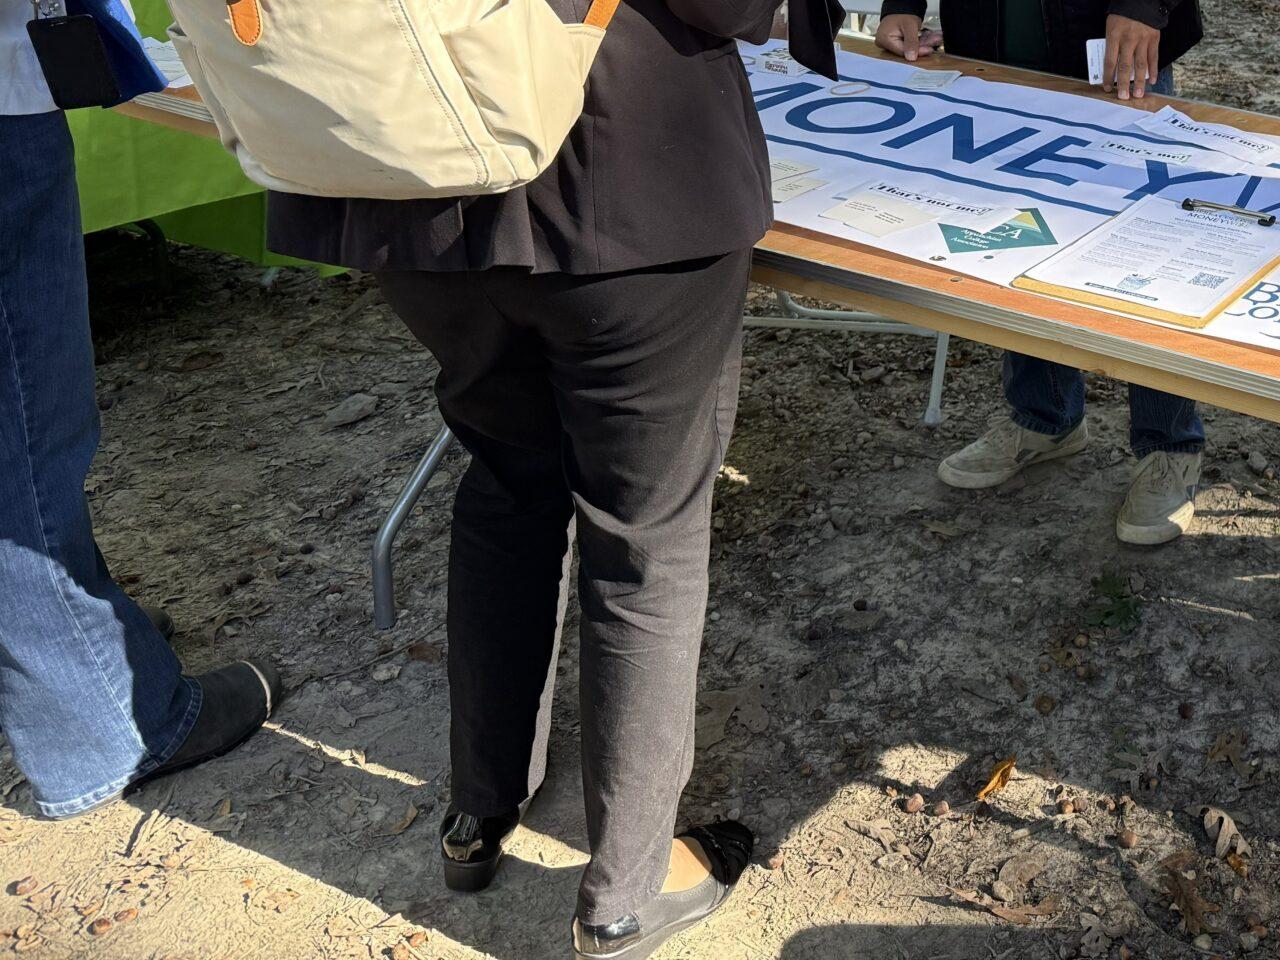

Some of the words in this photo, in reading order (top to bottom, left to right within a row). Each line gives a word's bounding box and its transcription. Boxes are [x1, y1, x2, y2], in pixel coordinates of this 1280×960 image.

[1108, 142, 1152, 155] That's
[1157, 150, 1186, 161] me!
[877, 183, 922, 202] That's
[926, 196, 953, 208] not
[955, 203, 987, 215] me!
[989, 224, 1023, 240] CA
